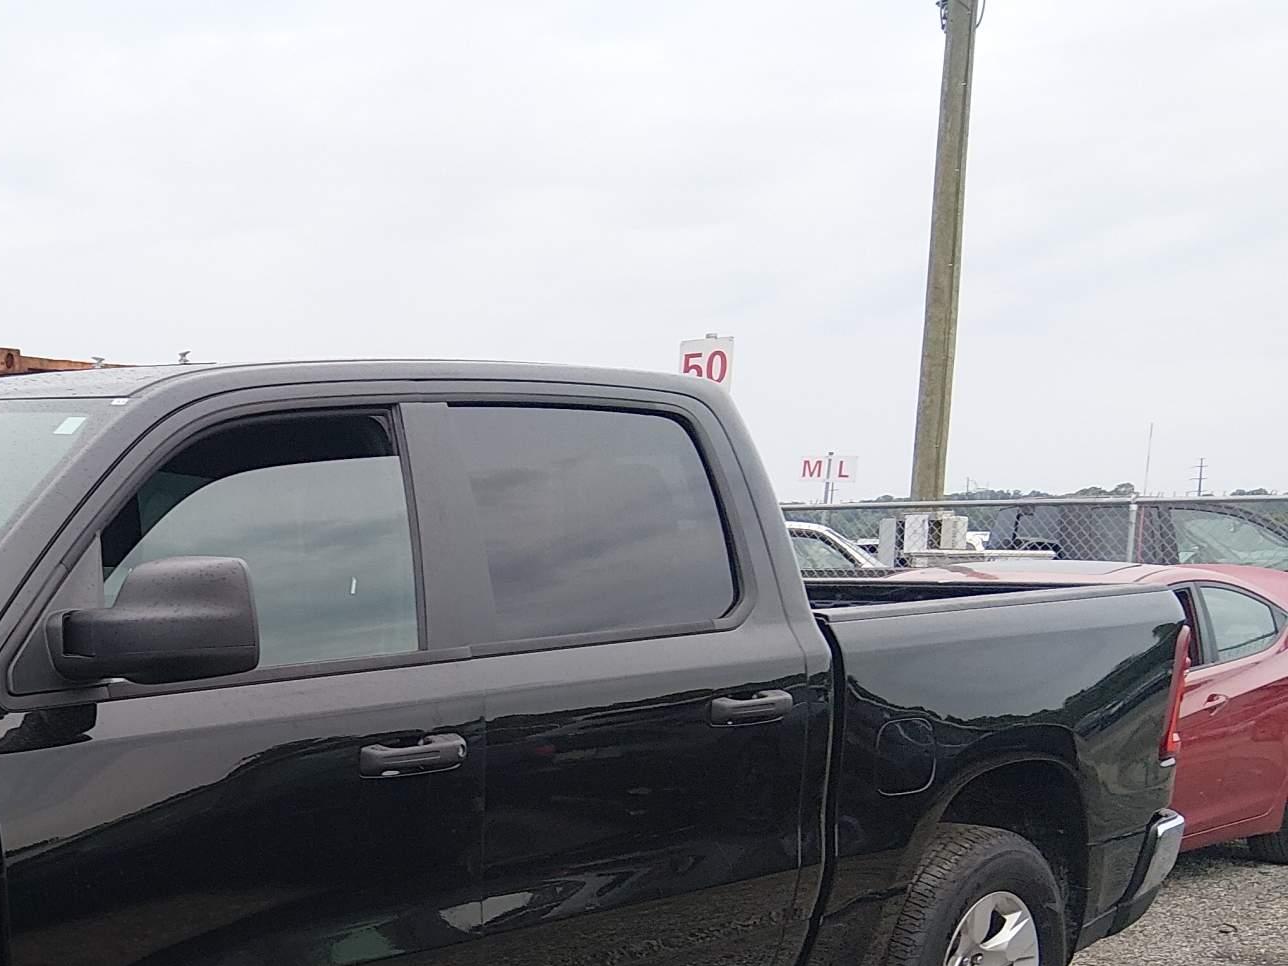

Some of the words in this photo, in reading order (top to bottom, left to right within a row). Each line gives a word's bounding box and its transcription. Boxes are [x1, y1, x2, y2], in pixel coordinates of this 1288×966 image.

[682, 350, 728, 383] 50
[802, 460, 822, 478] M
[838, 460, 849, 478] L
